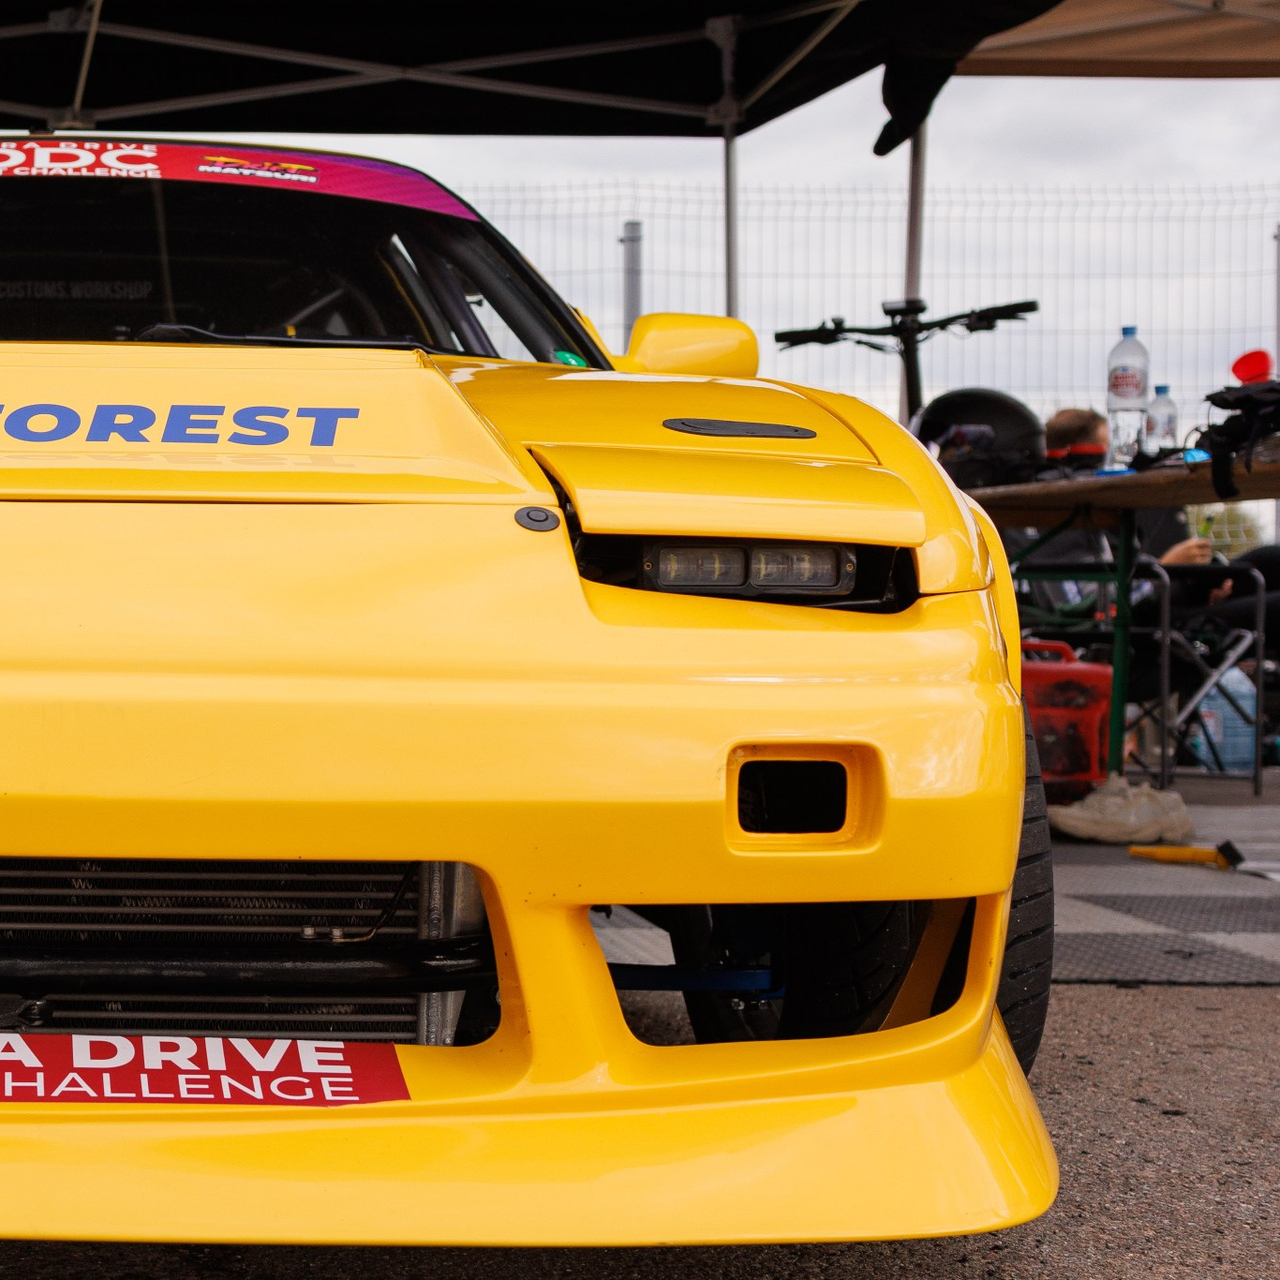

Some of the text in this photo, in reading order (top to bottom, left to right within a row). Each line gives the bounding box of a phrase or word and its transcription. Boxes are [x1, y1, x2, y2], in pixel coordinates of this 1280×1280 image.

[58, 142, 158, 152] DRIVE
[13, 167, 162, 179] CHALLENGE
[198, 165, 318, 183] MATSURI
[71, 1034, 352, 1074] DRIVE
